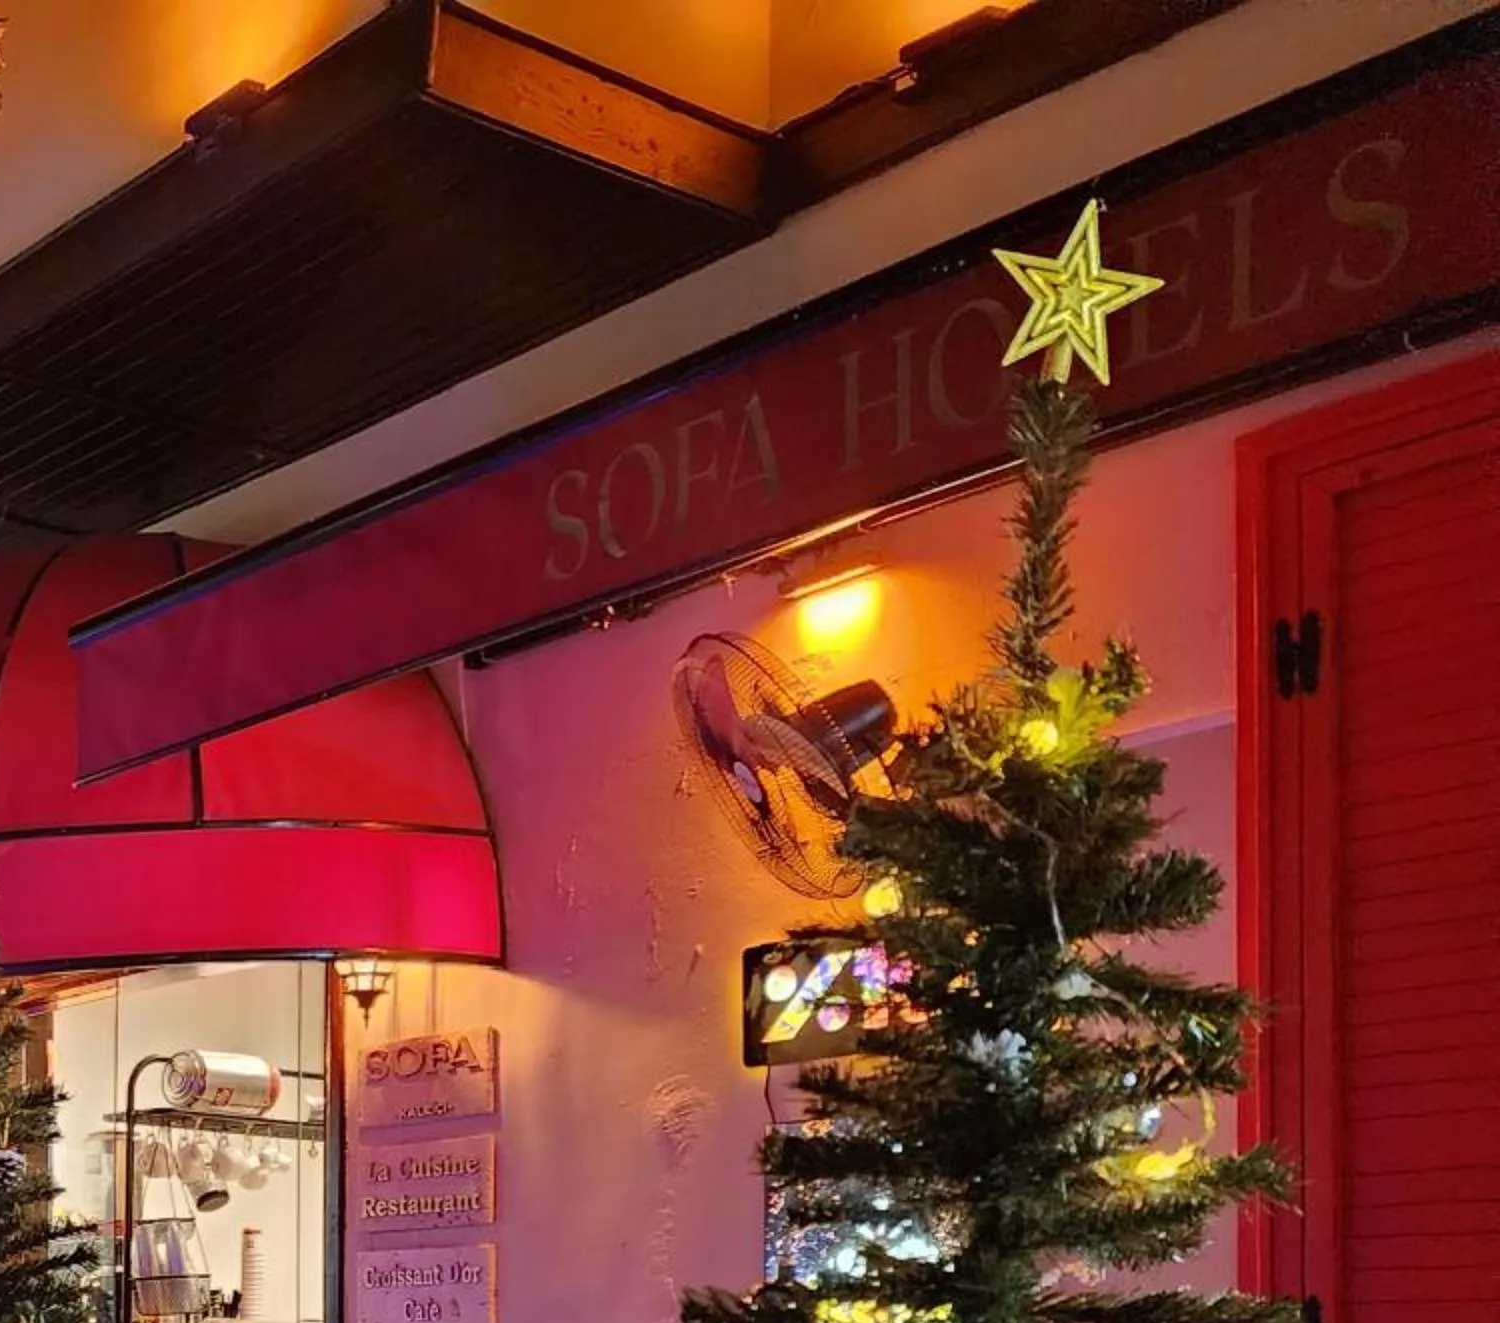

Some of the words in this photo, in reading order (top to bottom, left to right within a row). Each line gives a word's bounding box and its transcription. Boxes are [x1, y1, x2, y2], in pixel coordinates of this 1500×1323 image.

[542, 392, 782, 582] SOFA
[836, 137, 1410, 473] HOELS
[365, 1035, 484, 1086] SOFA
[399, 1155, 482, 1181] Cuisine
[360, 1187, 481, 1220] Restaurant
[363, 1263, 443, 1290] Croissant
